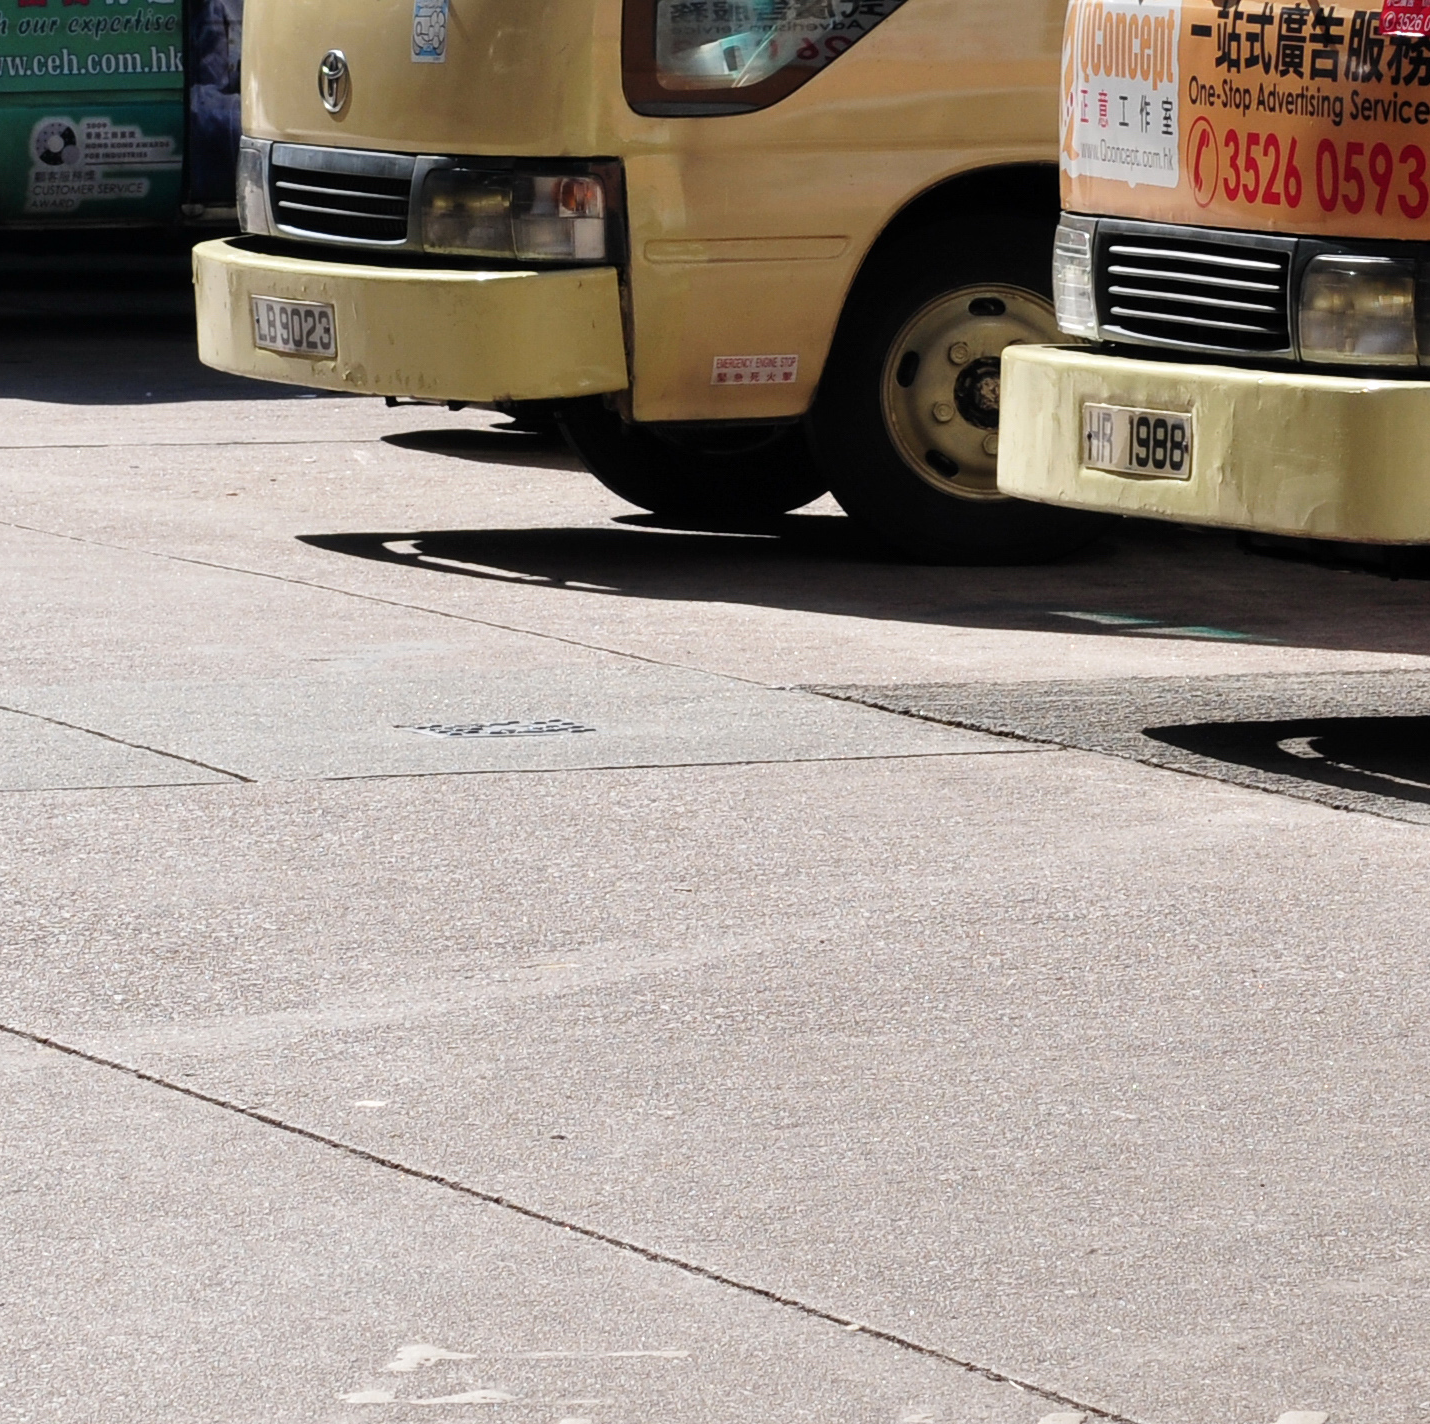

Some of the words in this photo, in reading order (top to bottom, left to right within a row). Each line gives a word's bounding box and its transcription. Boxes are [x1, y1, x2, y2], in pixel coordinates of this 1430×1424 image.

[17, 15, 59, 36] our
[68, 8, 178, 40] expertise
[1396, 12, 1423, 31] 3526
[1188, 75, 1253, 117] One-Stop
[1255, 84, 1344, 128] Advertising
[32, 184, 94, 196] CUSTOMER
[97, 182, 144, 194] SERVICE
[1223, 127, 1303, 209] 3526
[1315, 138, 1430, 221] 0593
[1088, 410, 1113, 464] HR
[1128, 414, 1186, 472] 1988
